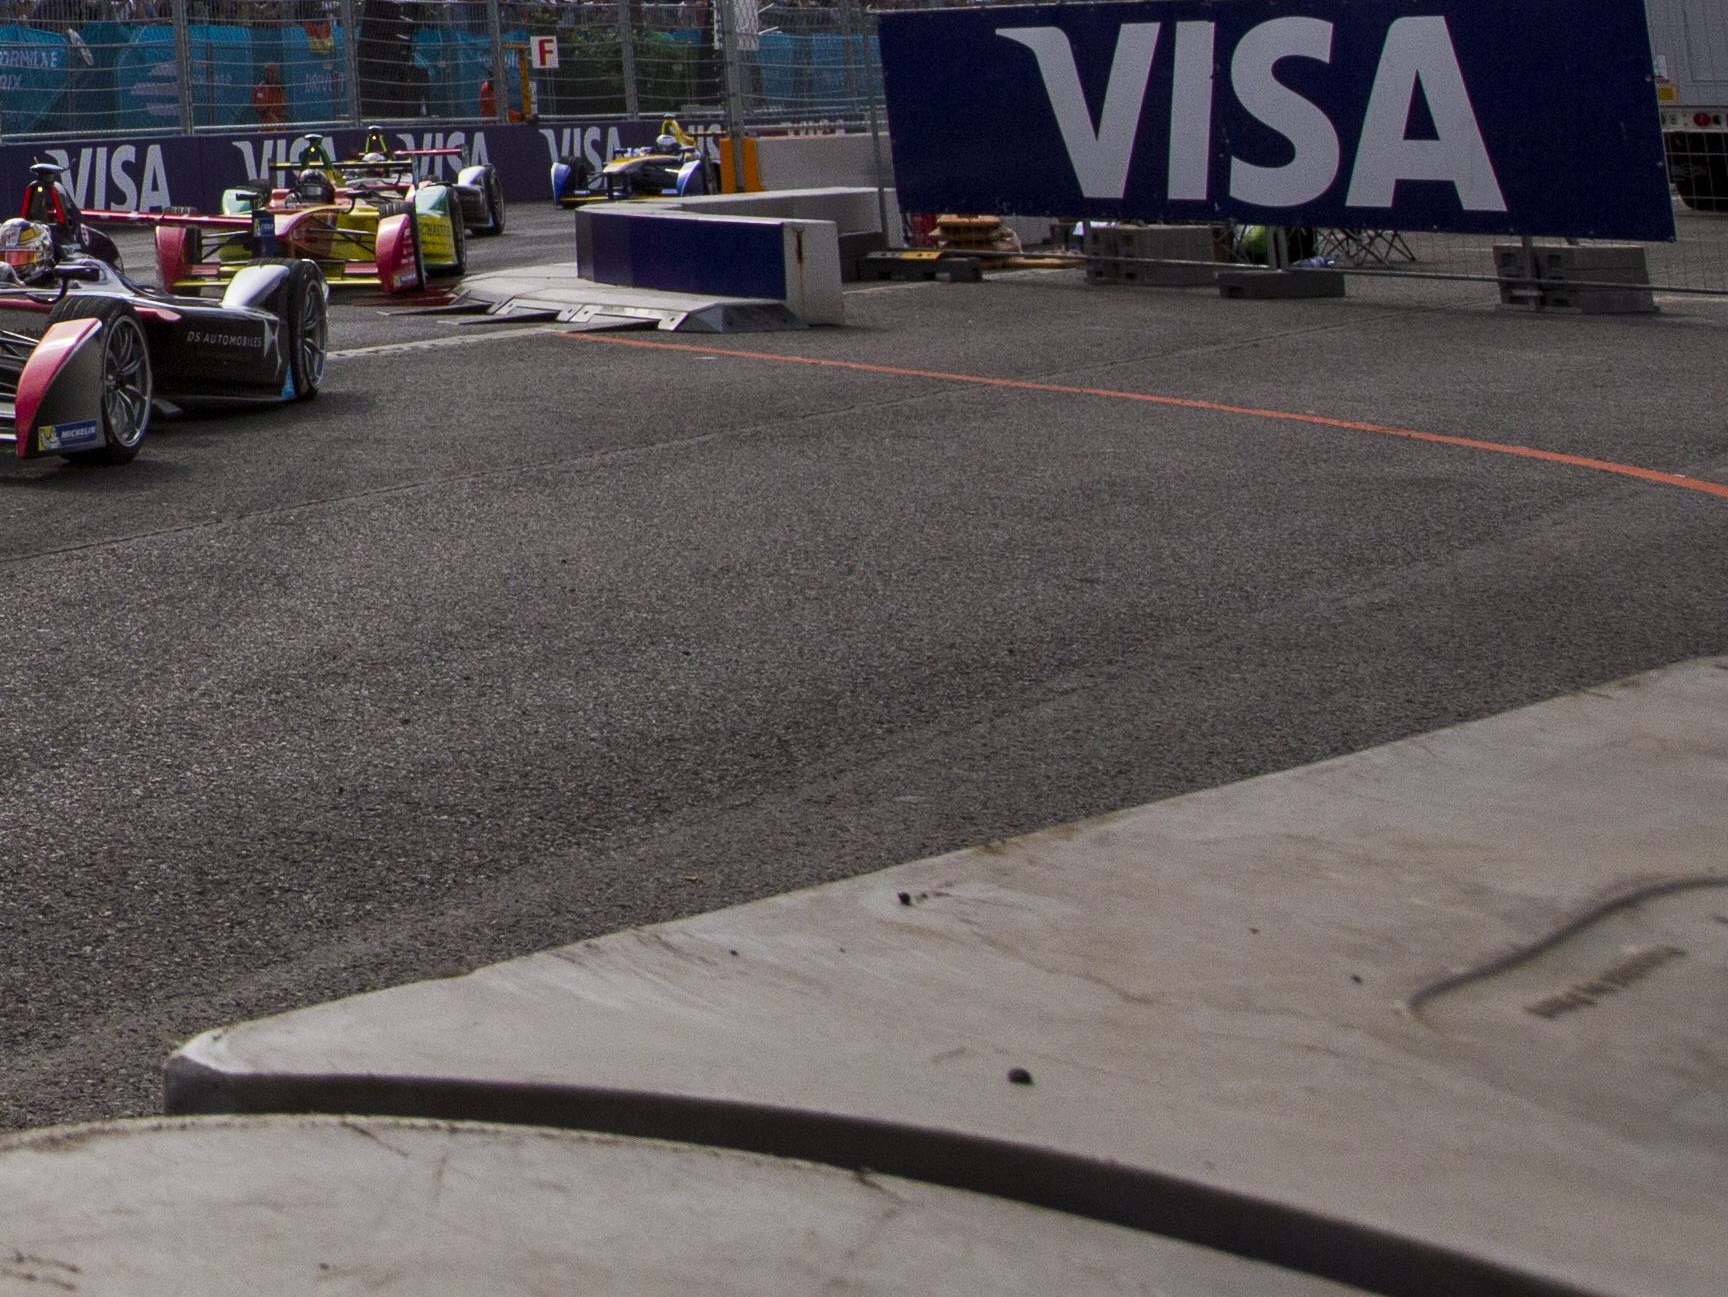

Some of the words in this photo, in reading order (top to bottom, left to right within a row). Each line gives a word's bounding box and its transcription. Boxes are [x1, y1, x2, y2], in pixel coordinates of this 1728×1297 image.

[539, 38, 554, 66] F
[994, 15, 1508, 212] VISA
[44, 144, 172, 214] VISA
[186, 330, 202, 343] DS
[202, 331, 263, 349] AUTOMOBILES
[60, 425, 96, 442] MICHELIN
